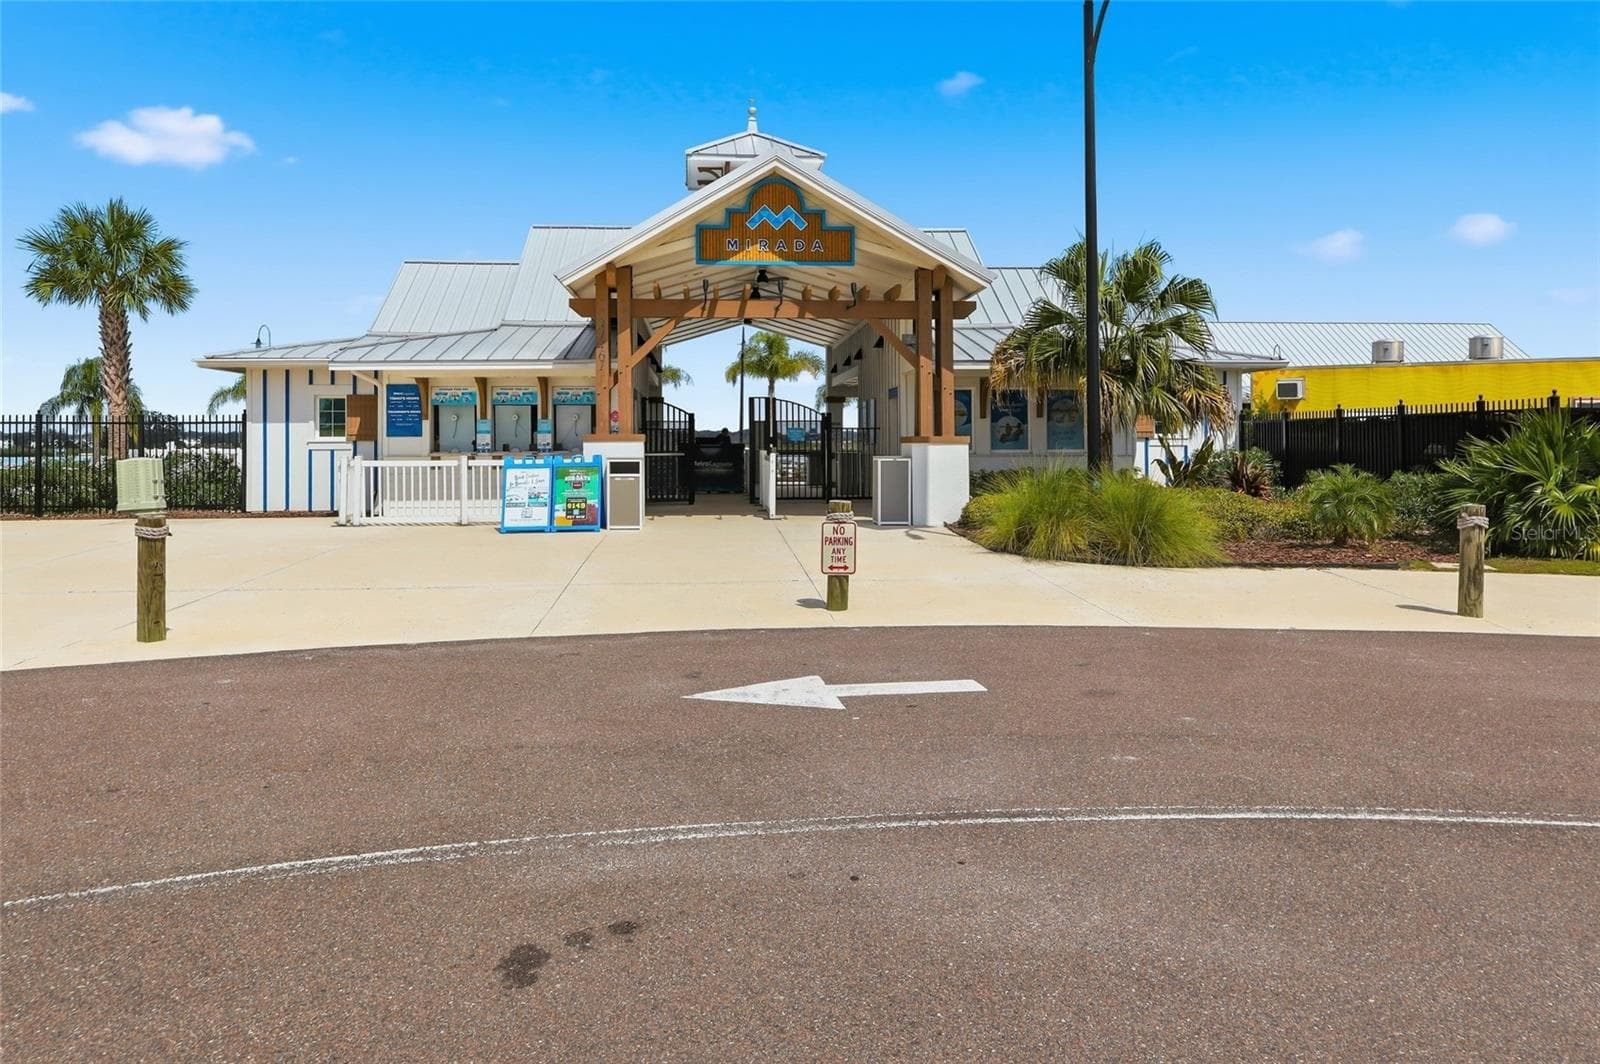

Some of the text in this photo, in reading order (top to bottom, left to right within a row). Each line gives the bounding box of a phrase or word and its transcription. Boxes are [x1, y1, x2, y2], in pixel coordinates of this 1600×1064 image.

[726, 238, 824, 252] MIRADA
[832, 526, 846, 536] NO
[824, 536, 854, 546] PARKING
[831, 547, 847, 555] ANY
[830, 555, 847, 563] TIME
